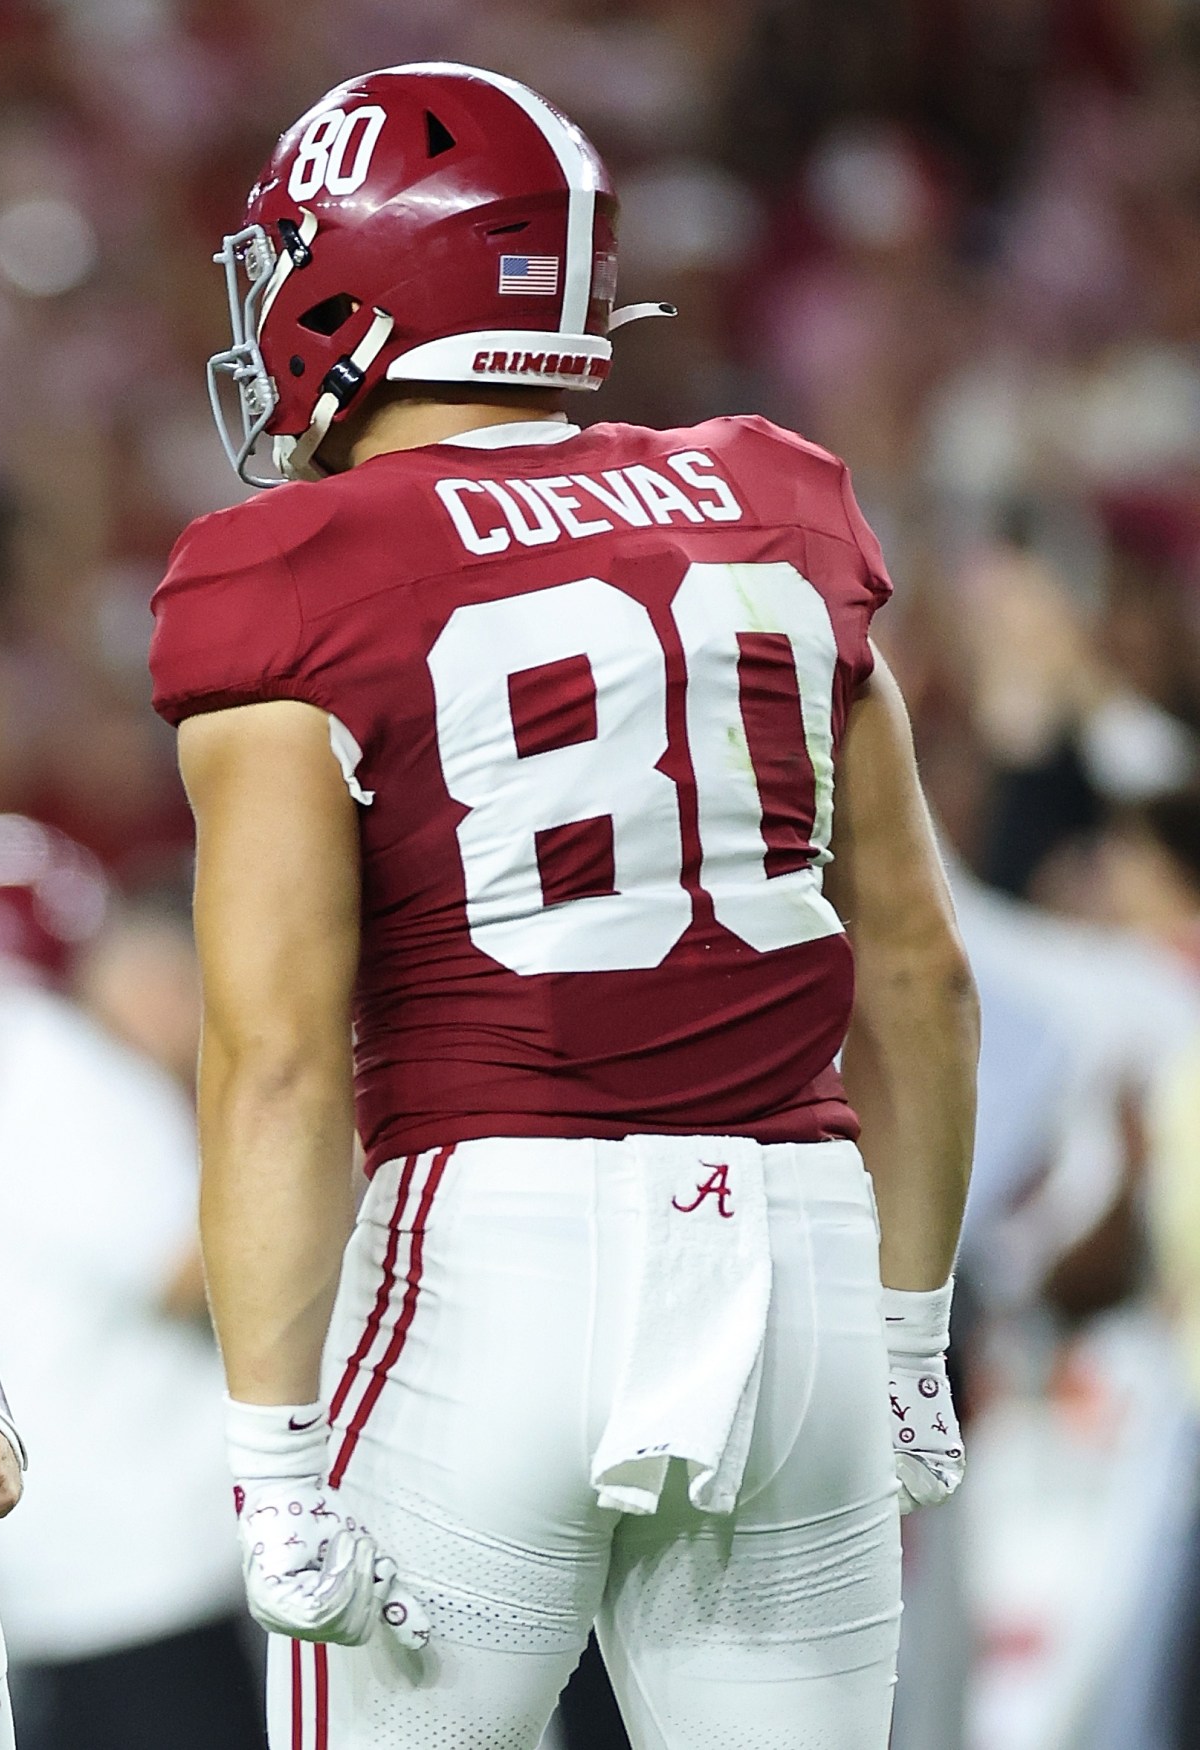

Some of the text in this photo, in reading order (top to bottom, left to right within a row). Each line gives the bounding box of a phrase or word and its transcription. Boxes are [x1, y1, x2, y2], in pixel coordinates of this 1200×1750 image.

[287, 105, 387, 202] 80
[434, 451, 744, 556] CUEVAS
[426, 562, 846, 976] 80
[672, 1159, 735, 1218] A
